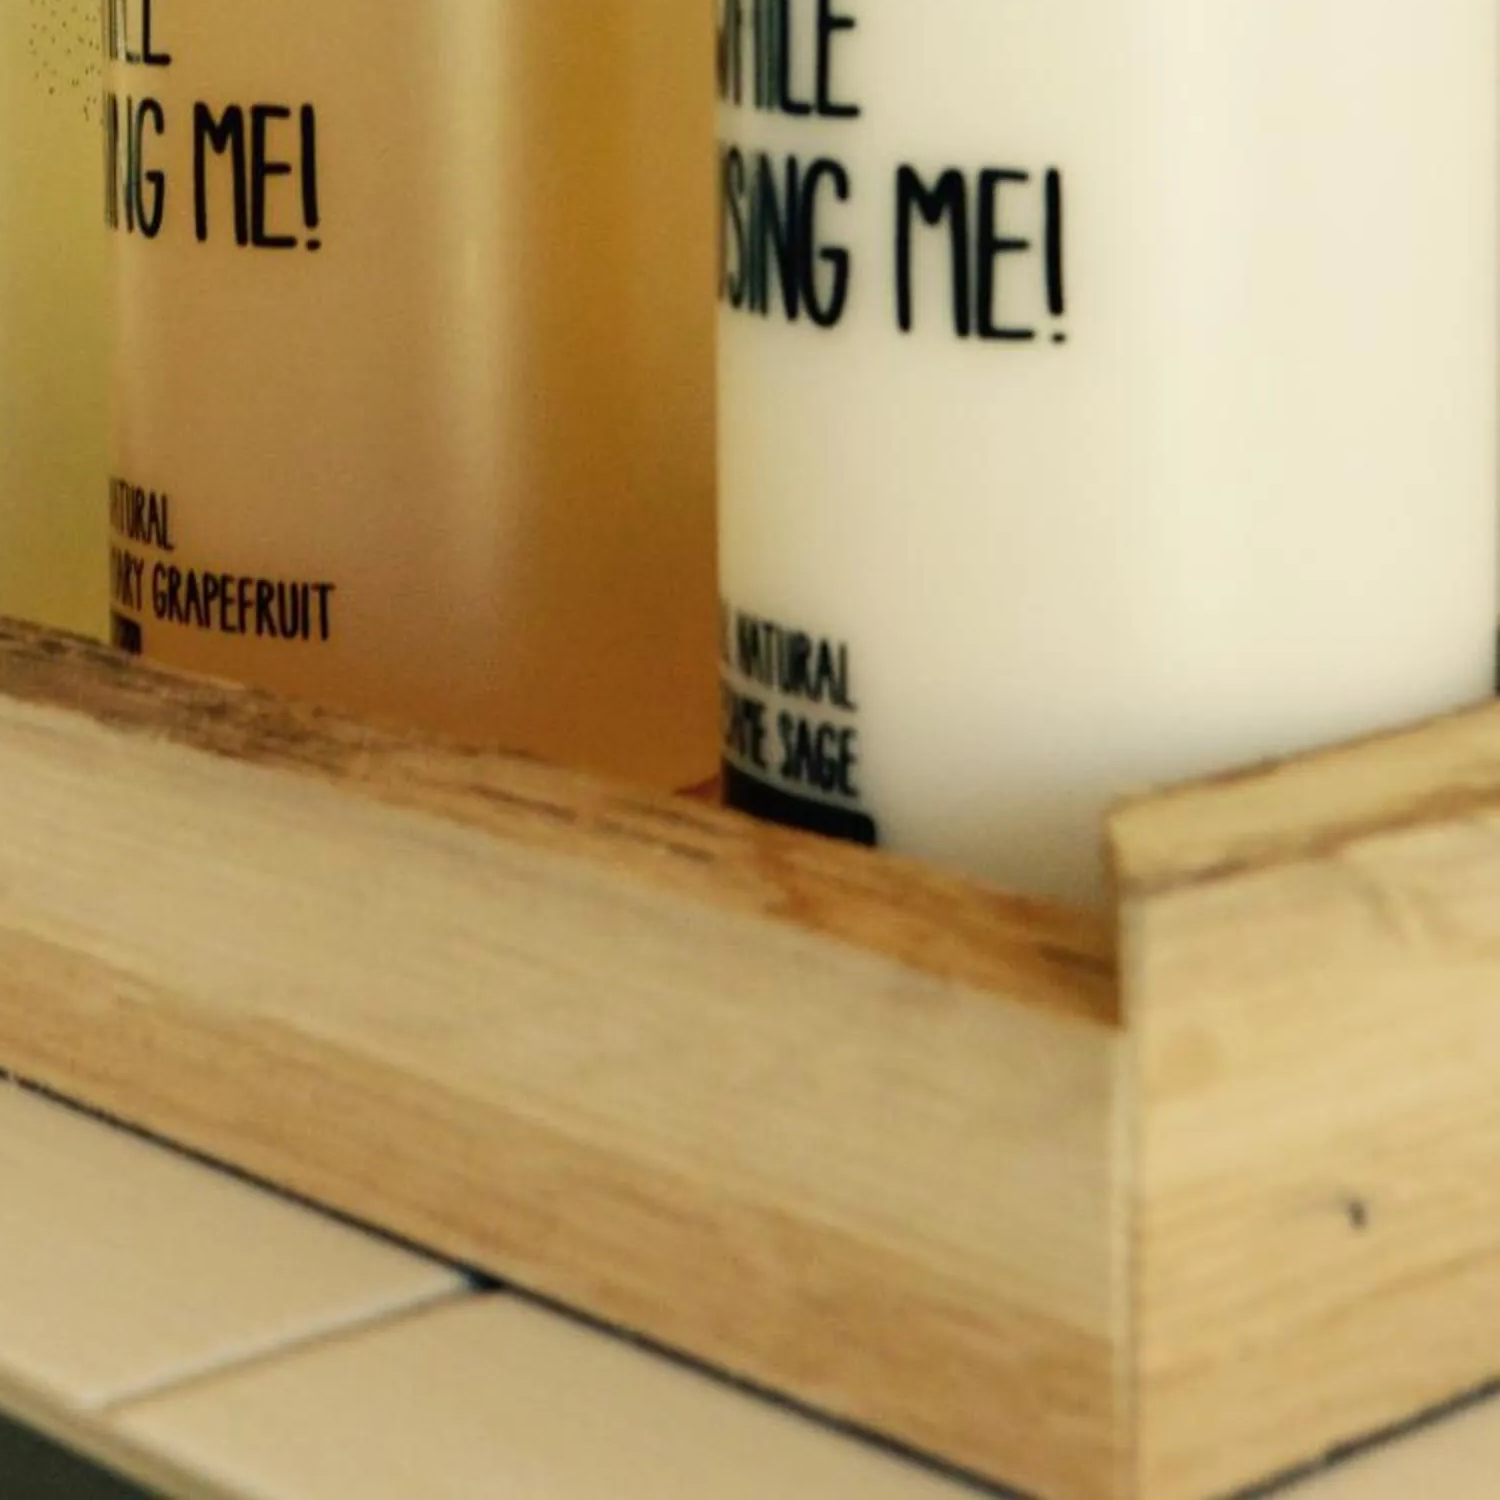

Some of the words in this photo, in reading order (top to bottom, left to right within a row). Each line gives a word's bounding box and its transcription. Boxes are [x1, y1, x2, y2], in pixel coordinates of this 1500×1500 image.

[193, 101, 321, 252] ME!
[894, 163, 1068, 345] ME!
[152, 560, 337, 642] GRAPEFRUIT
[777, 709, 859, 797] SAGE
